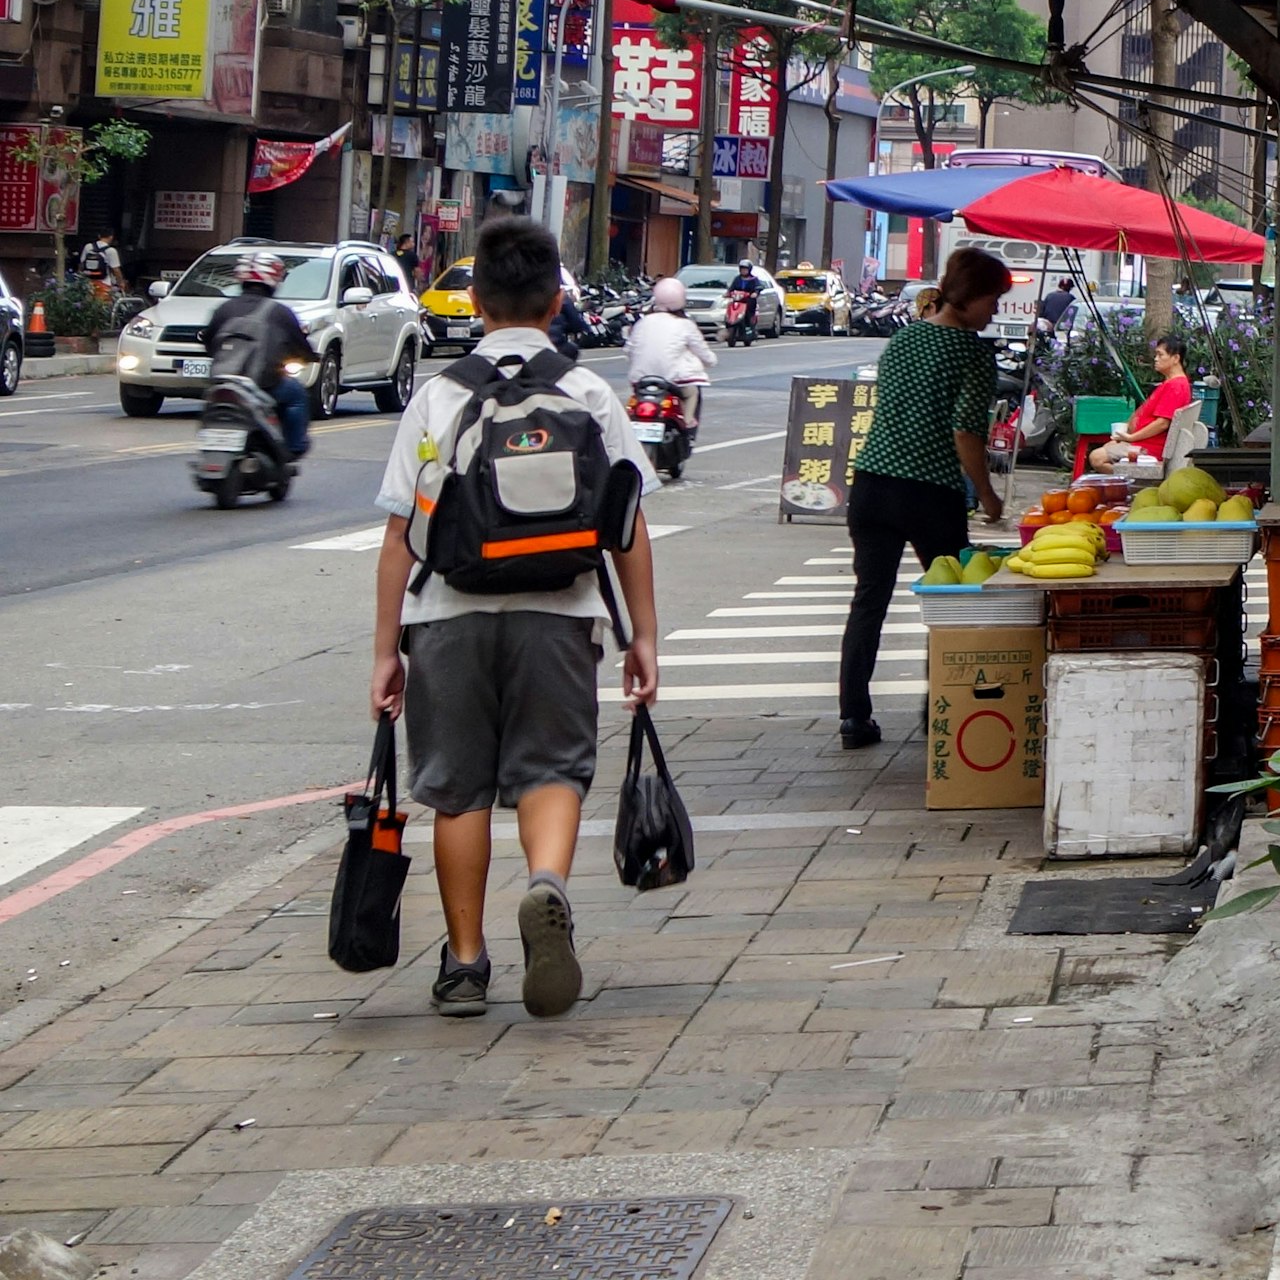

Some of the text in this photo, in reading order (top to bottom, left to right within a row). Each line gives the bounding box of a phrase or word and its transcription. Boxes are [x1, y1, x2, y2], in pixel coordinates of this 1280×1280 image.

[611, 35, 696, 122] 鞋
[737, 35, 772, 138] 全家福
[798, 384, 839, 485] 芋頭粥
[975, 667, 988, 685] A
[1022, 694, 1043, 779] 品質保證
